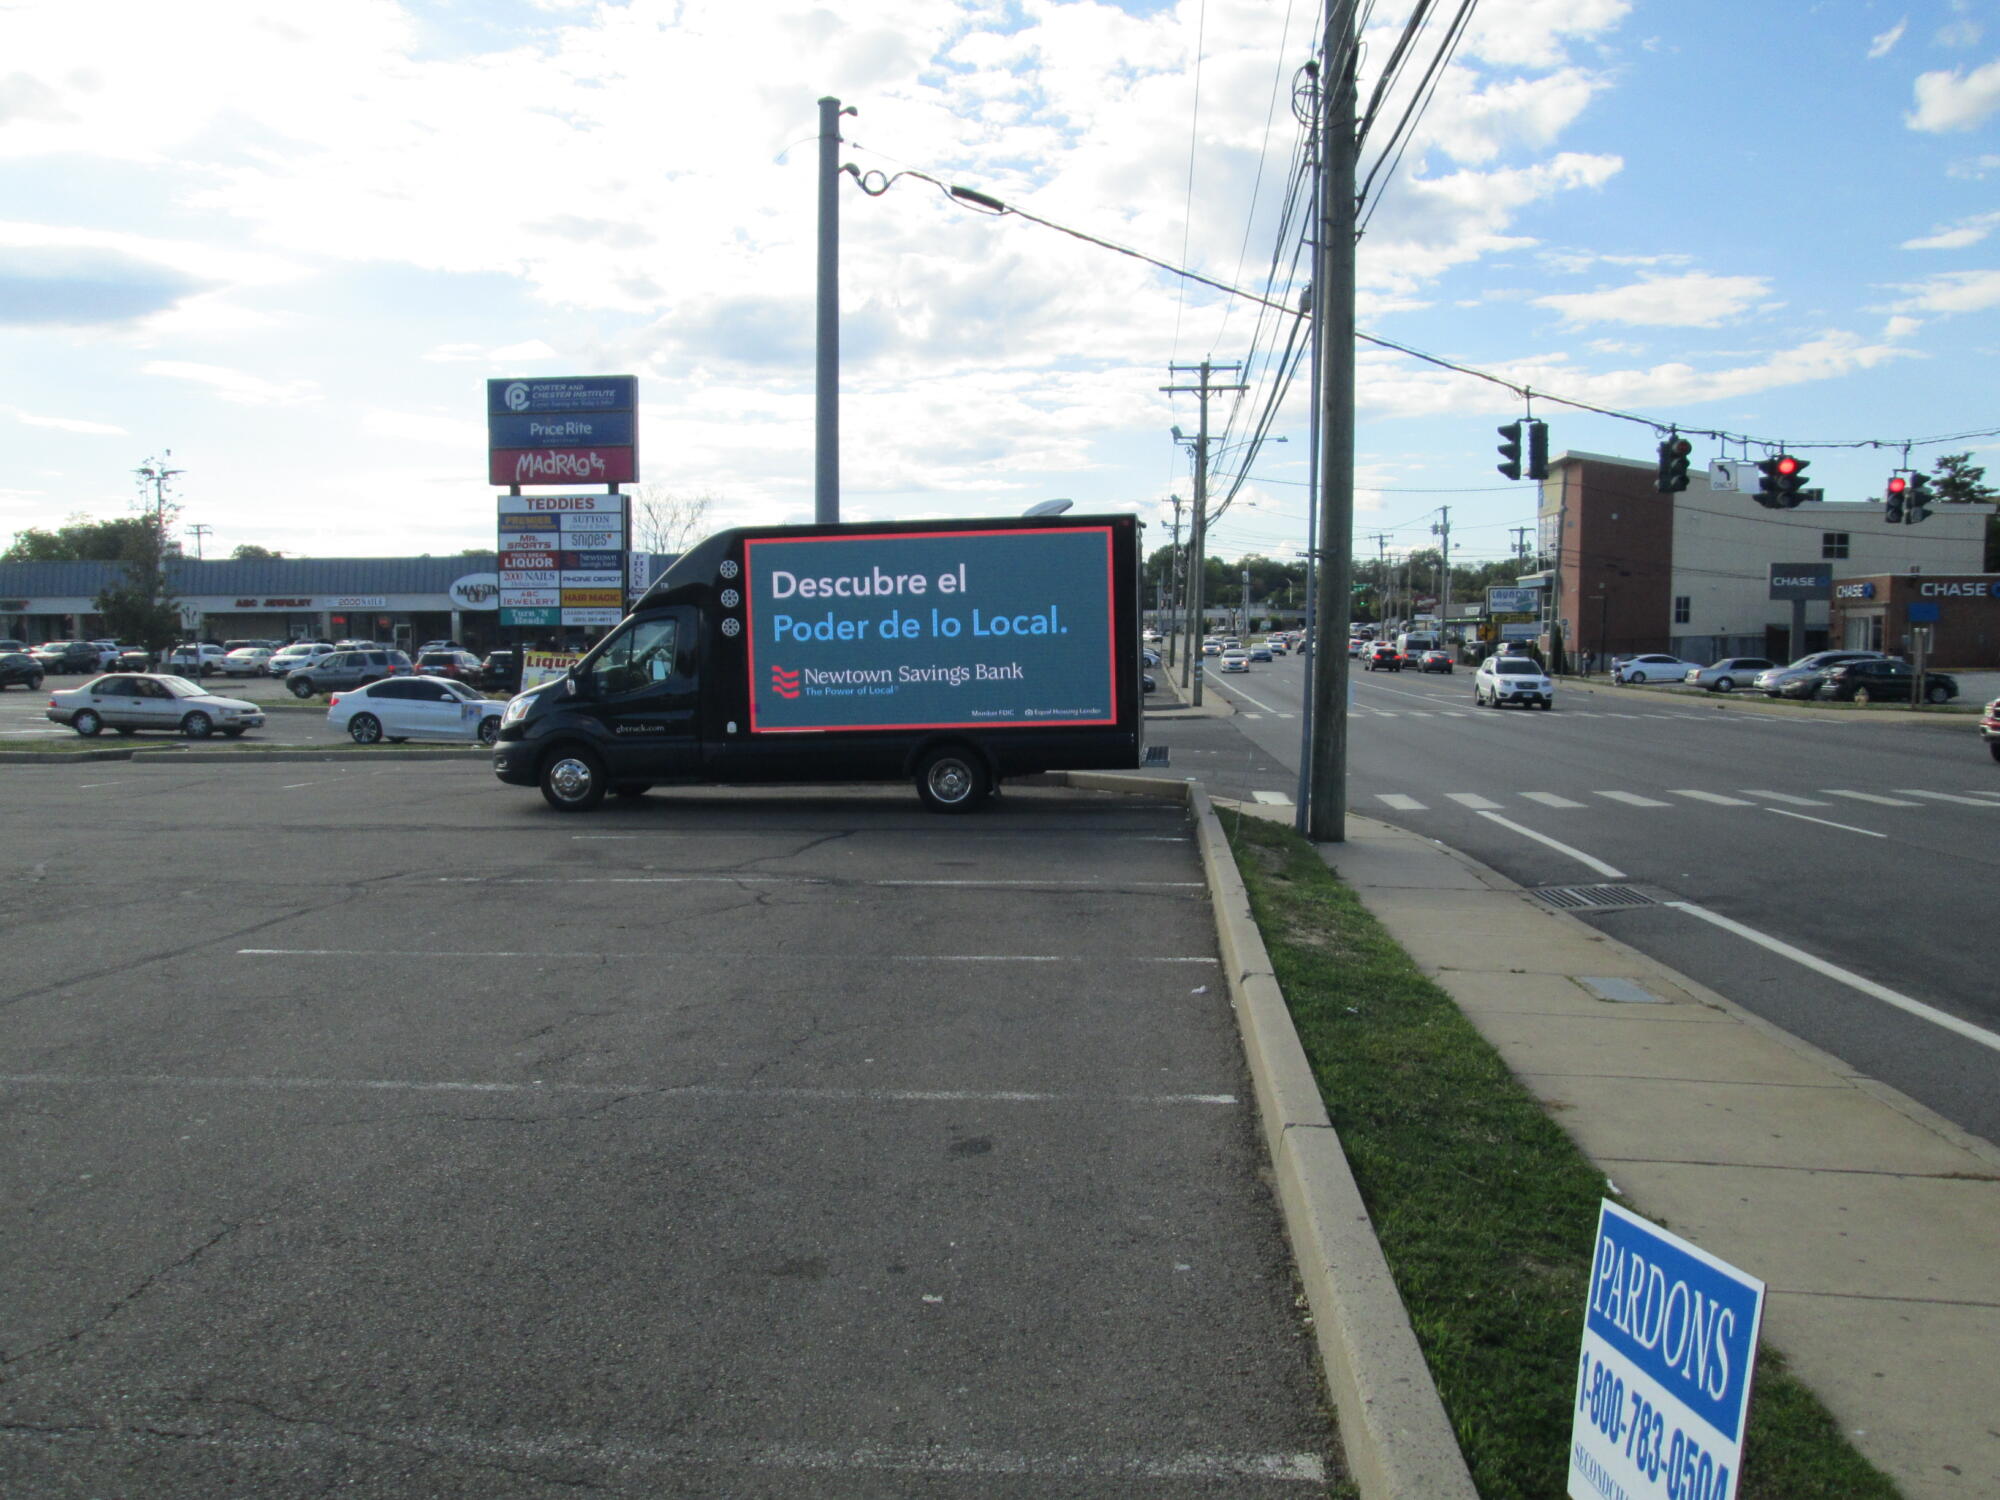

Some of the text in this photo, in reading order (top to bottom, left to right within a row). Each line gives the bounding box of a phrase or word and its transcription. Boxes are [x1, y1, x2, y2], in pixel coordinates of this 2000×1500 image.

[530, 421, 592, 436] Price Rite
[526, 497, 595, 510] TEDDIES
[572, 514, 609, 523] SUTTON
[571, 533, 607, 548] snipes
[505, 557, 553, 568] LIQUOR
[525, 571, 555, 580] NAILS
[772, 563, 966, 598] Descubre el
[1772, 577, 1816, 586] CHASE
[1836, 583, 1864, 598] CHASE
[1921, 583, 1988, 596] CHASE
[589, 593, 620, 601] MAGIC
[773, 605, 1067, 642] Poder de lo Local.
[805, 662, 1024, 686] Newtown Savings Bank
[806, 687, 823, 696] The
[825, 687, 854, 696] Power
[857, 686, 867, 694] of
[1593, 1236, 1735, 1401] PARDONS
